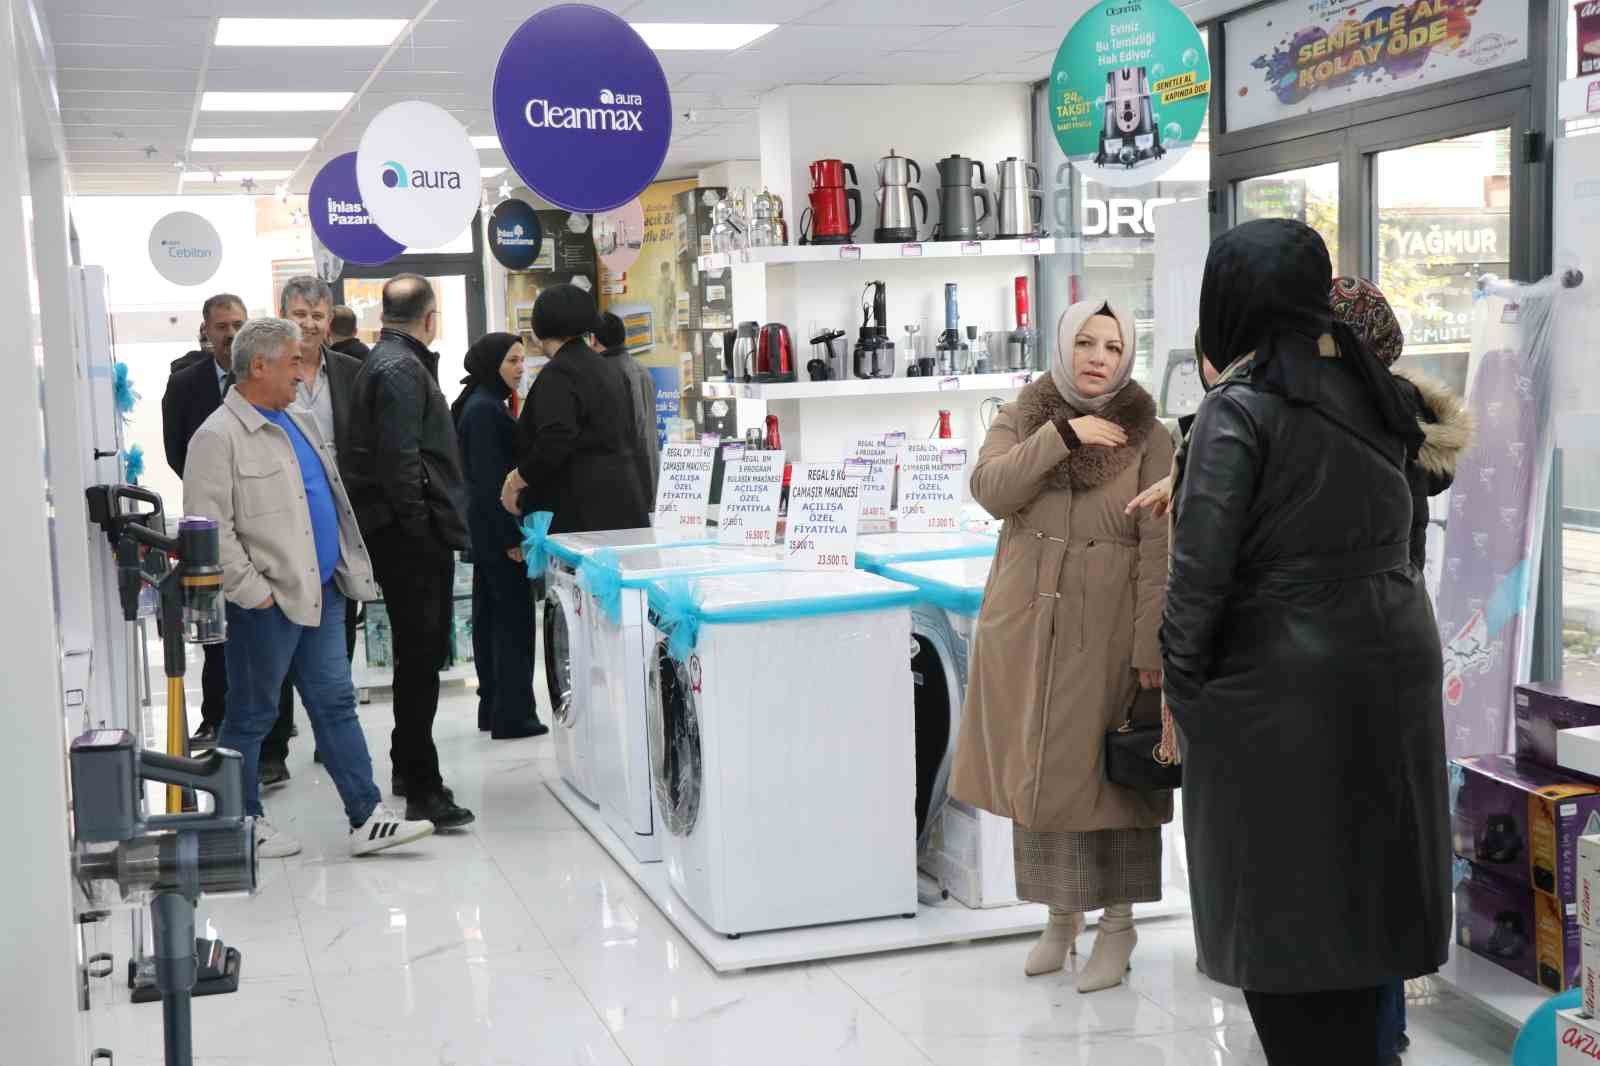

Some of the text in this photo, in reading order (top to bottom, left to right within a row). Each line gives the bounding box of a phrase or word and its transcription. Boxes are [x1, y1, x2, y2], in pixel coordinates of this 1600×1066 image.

[1299, 8, 1406, 63] SENETLE
[1413, 0, 1449, 22] AL
[1299, 40, 1384, 89] KOLAY
[1387, 26, 1448, 56] ÖDE
[615, 94, 643, 106] aura
[525, 98, 644, 132] Cleanmax
[411, 169, 462, 190] aura
[327, 197, 362, 213] İhlas
[1398, 225, 1497, 255] YAĞMUR
[667, 447, 682, 457] REGAL
[807, 469, 846, 481] REGAL 9 KG
[674, 481, 692, 490] ÖZEL
[918, 482, 941, 491] ÖZEL
[739, 493, 760, 502] ÖZEL
[809, 513, 834, 522] ÖZEL
[817, 554, 849, 566] 23.500 TL
